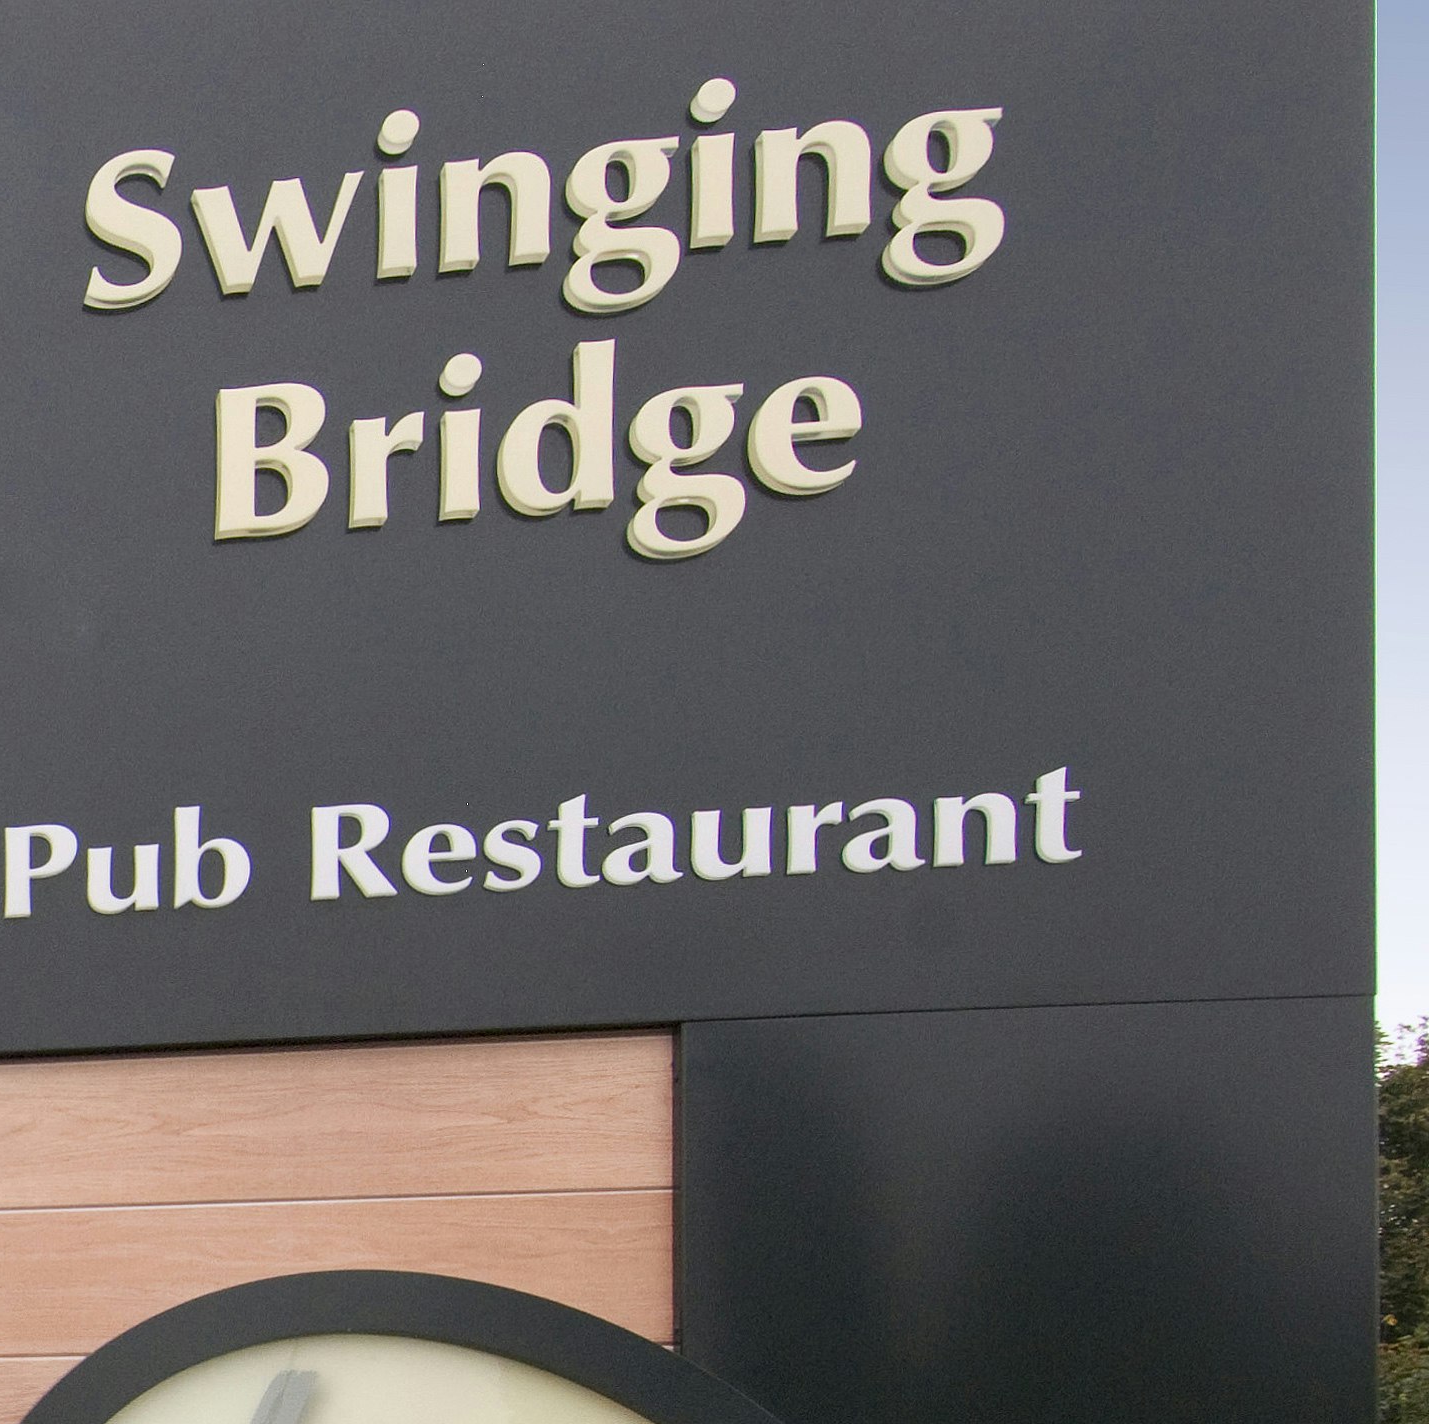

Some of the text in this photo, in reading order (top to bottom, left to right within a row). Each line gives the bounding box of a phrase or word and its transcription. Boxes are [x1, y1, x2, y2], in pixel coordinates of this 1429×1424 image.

[82, 77, 1006, 314] Swinging
[213, 339, 864, 560] Bridge
[3, 766, 1083, 919] Pub Restaurant
